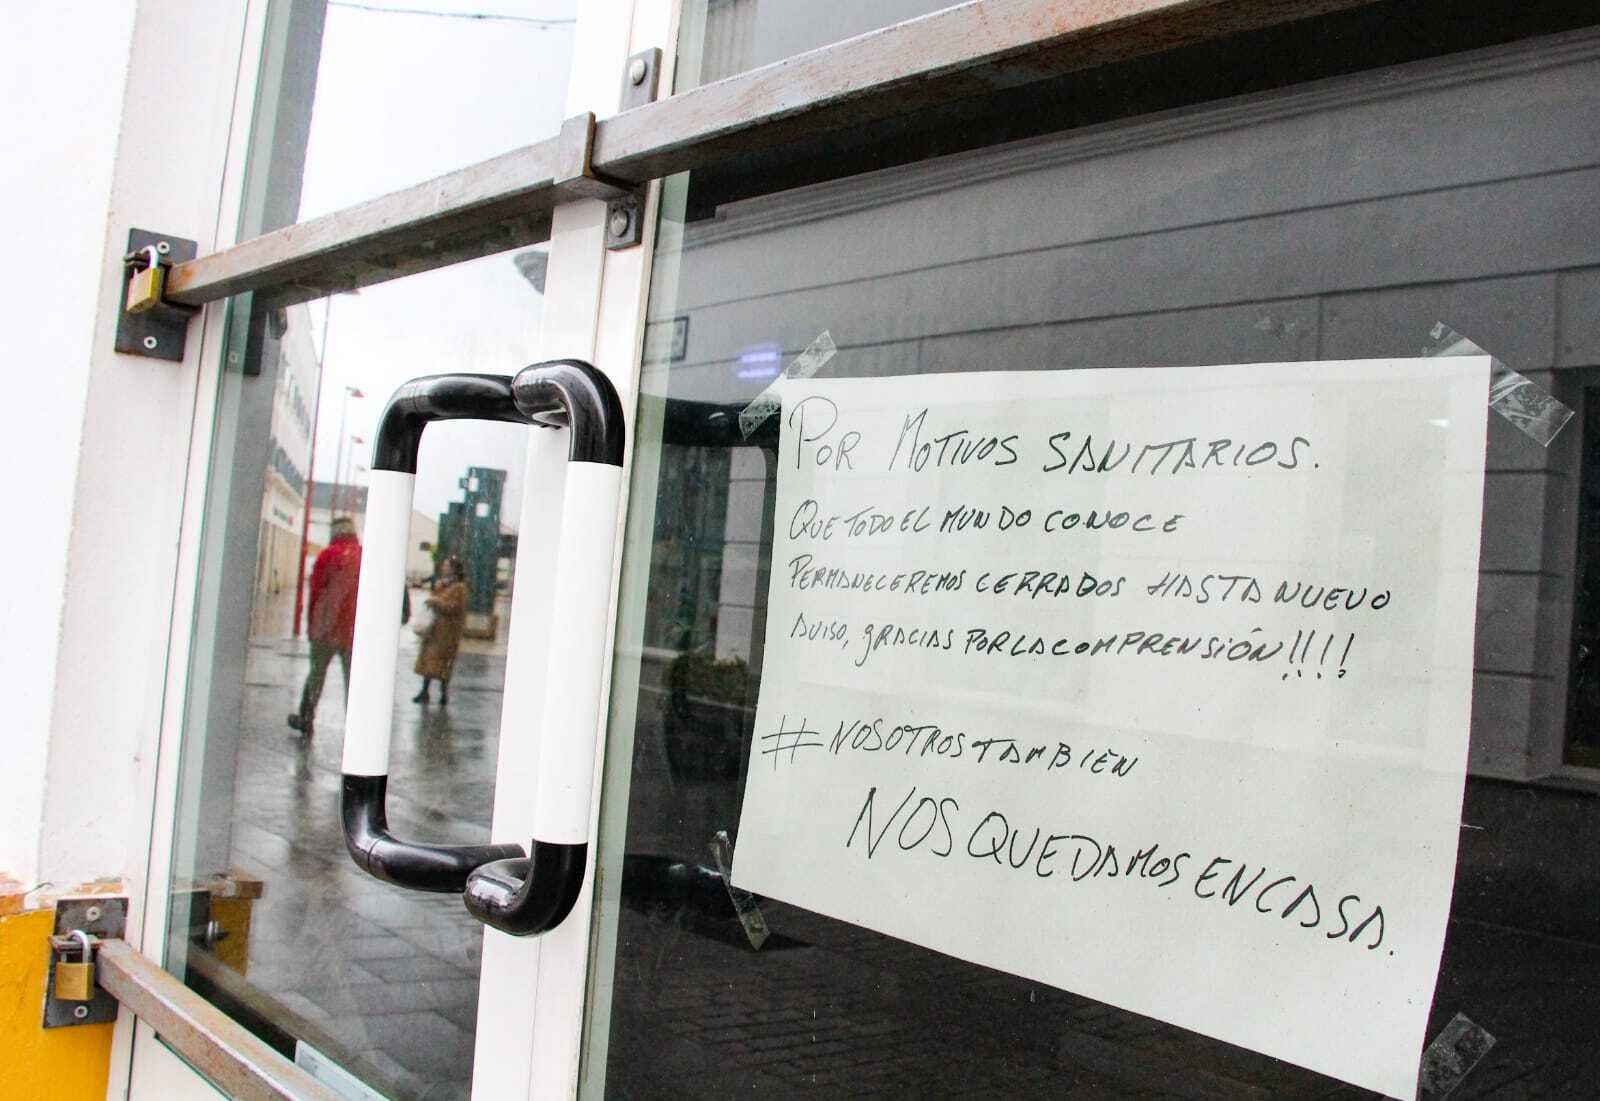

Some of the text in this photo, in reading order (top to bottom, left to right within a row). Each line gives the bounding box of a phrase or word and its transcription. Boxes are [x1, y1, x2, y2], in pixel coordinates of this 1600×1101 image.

[788, 395, 1320, 476] POR MOTIVOS SANITARIOS.
[789, 498, 841, 541] QUE
[843, 505, 895, 538] TODO
[899, 505, 931, 534] EL
[1043, 509, 1186, 534] CONOCE
[788, 553, 1391, 612] PERMANECEREMOS CERRADOS HASTA NUEVO
[789, 611, 849, 649] AVISO,
[845, 785, 1395, 957] NOS QUEDAMOS EN CASA.
